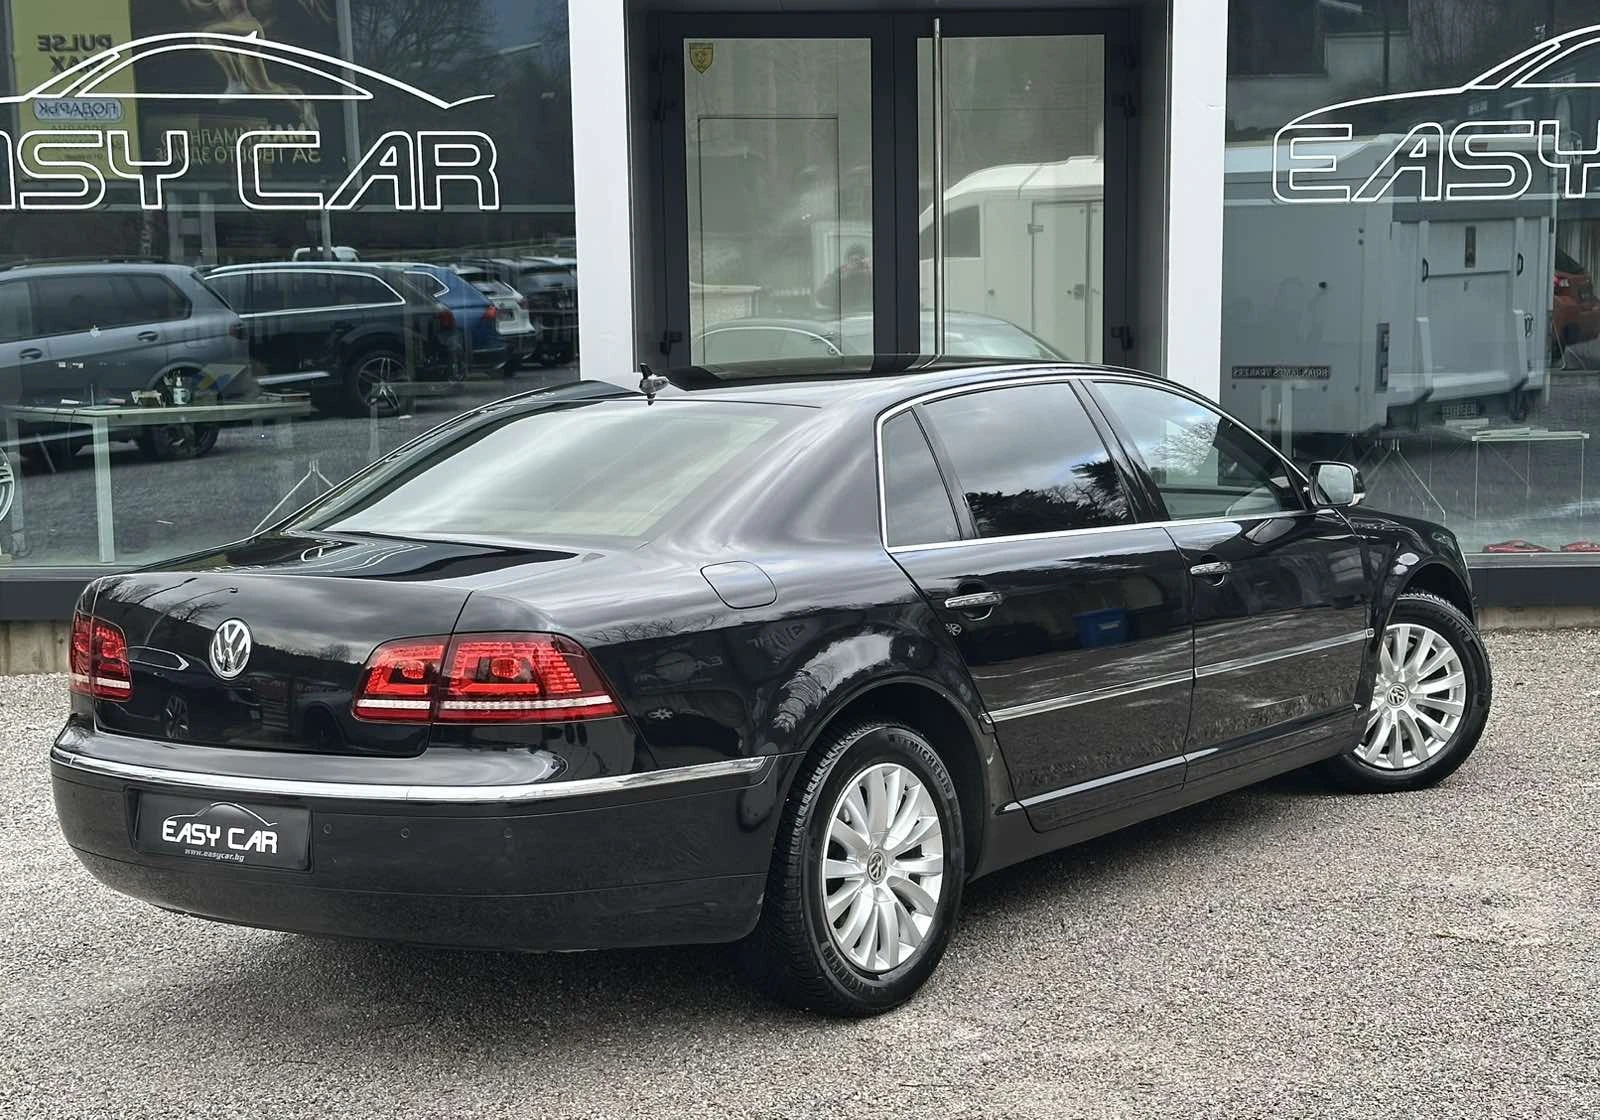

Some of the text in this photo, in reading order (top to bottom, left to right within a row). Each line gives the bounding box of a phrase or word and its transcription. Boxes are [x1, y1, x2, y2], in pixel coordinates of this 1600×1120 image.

[0, 130, 500, 210] SY CAR
[162, 820, 279, 854] EASY CAR
[184, 848, 245, 862] www.easycar.bg
